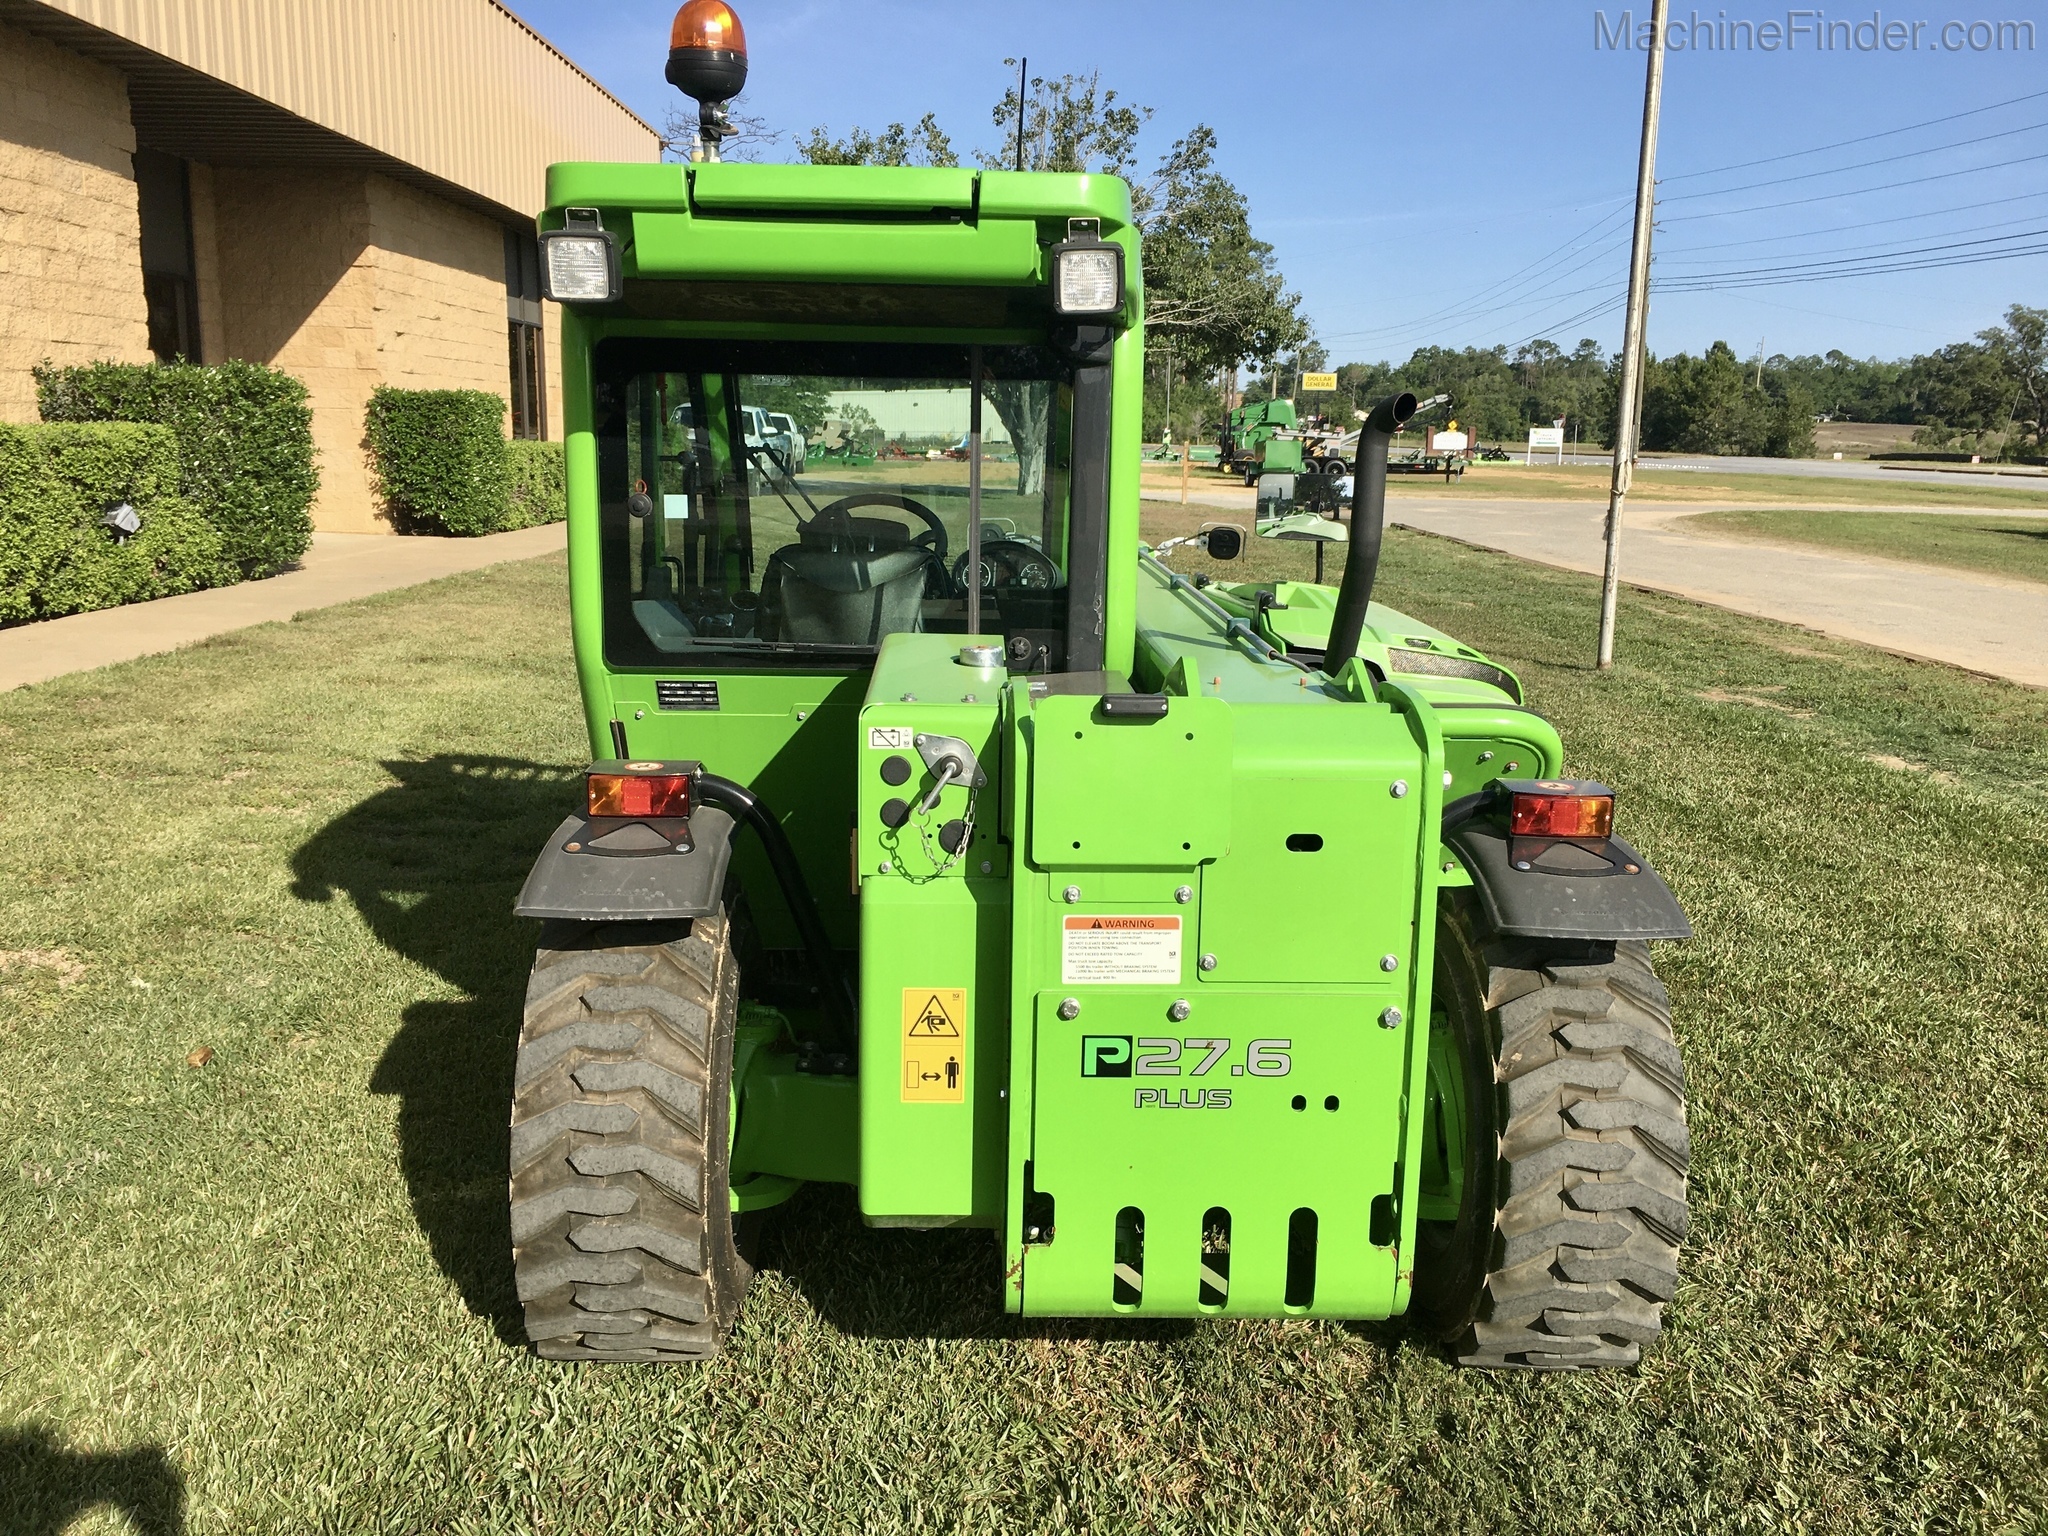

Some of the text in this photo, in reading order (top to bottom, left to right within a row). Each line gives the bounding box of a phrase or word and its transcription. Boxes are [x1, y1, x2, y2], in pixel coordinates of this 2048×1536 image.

[1105, 920, 1155, 928] WARNING
[1081, 1035, 1292, 1078] P27.6
[1134, 1088, 1232, 1109] PLUS
